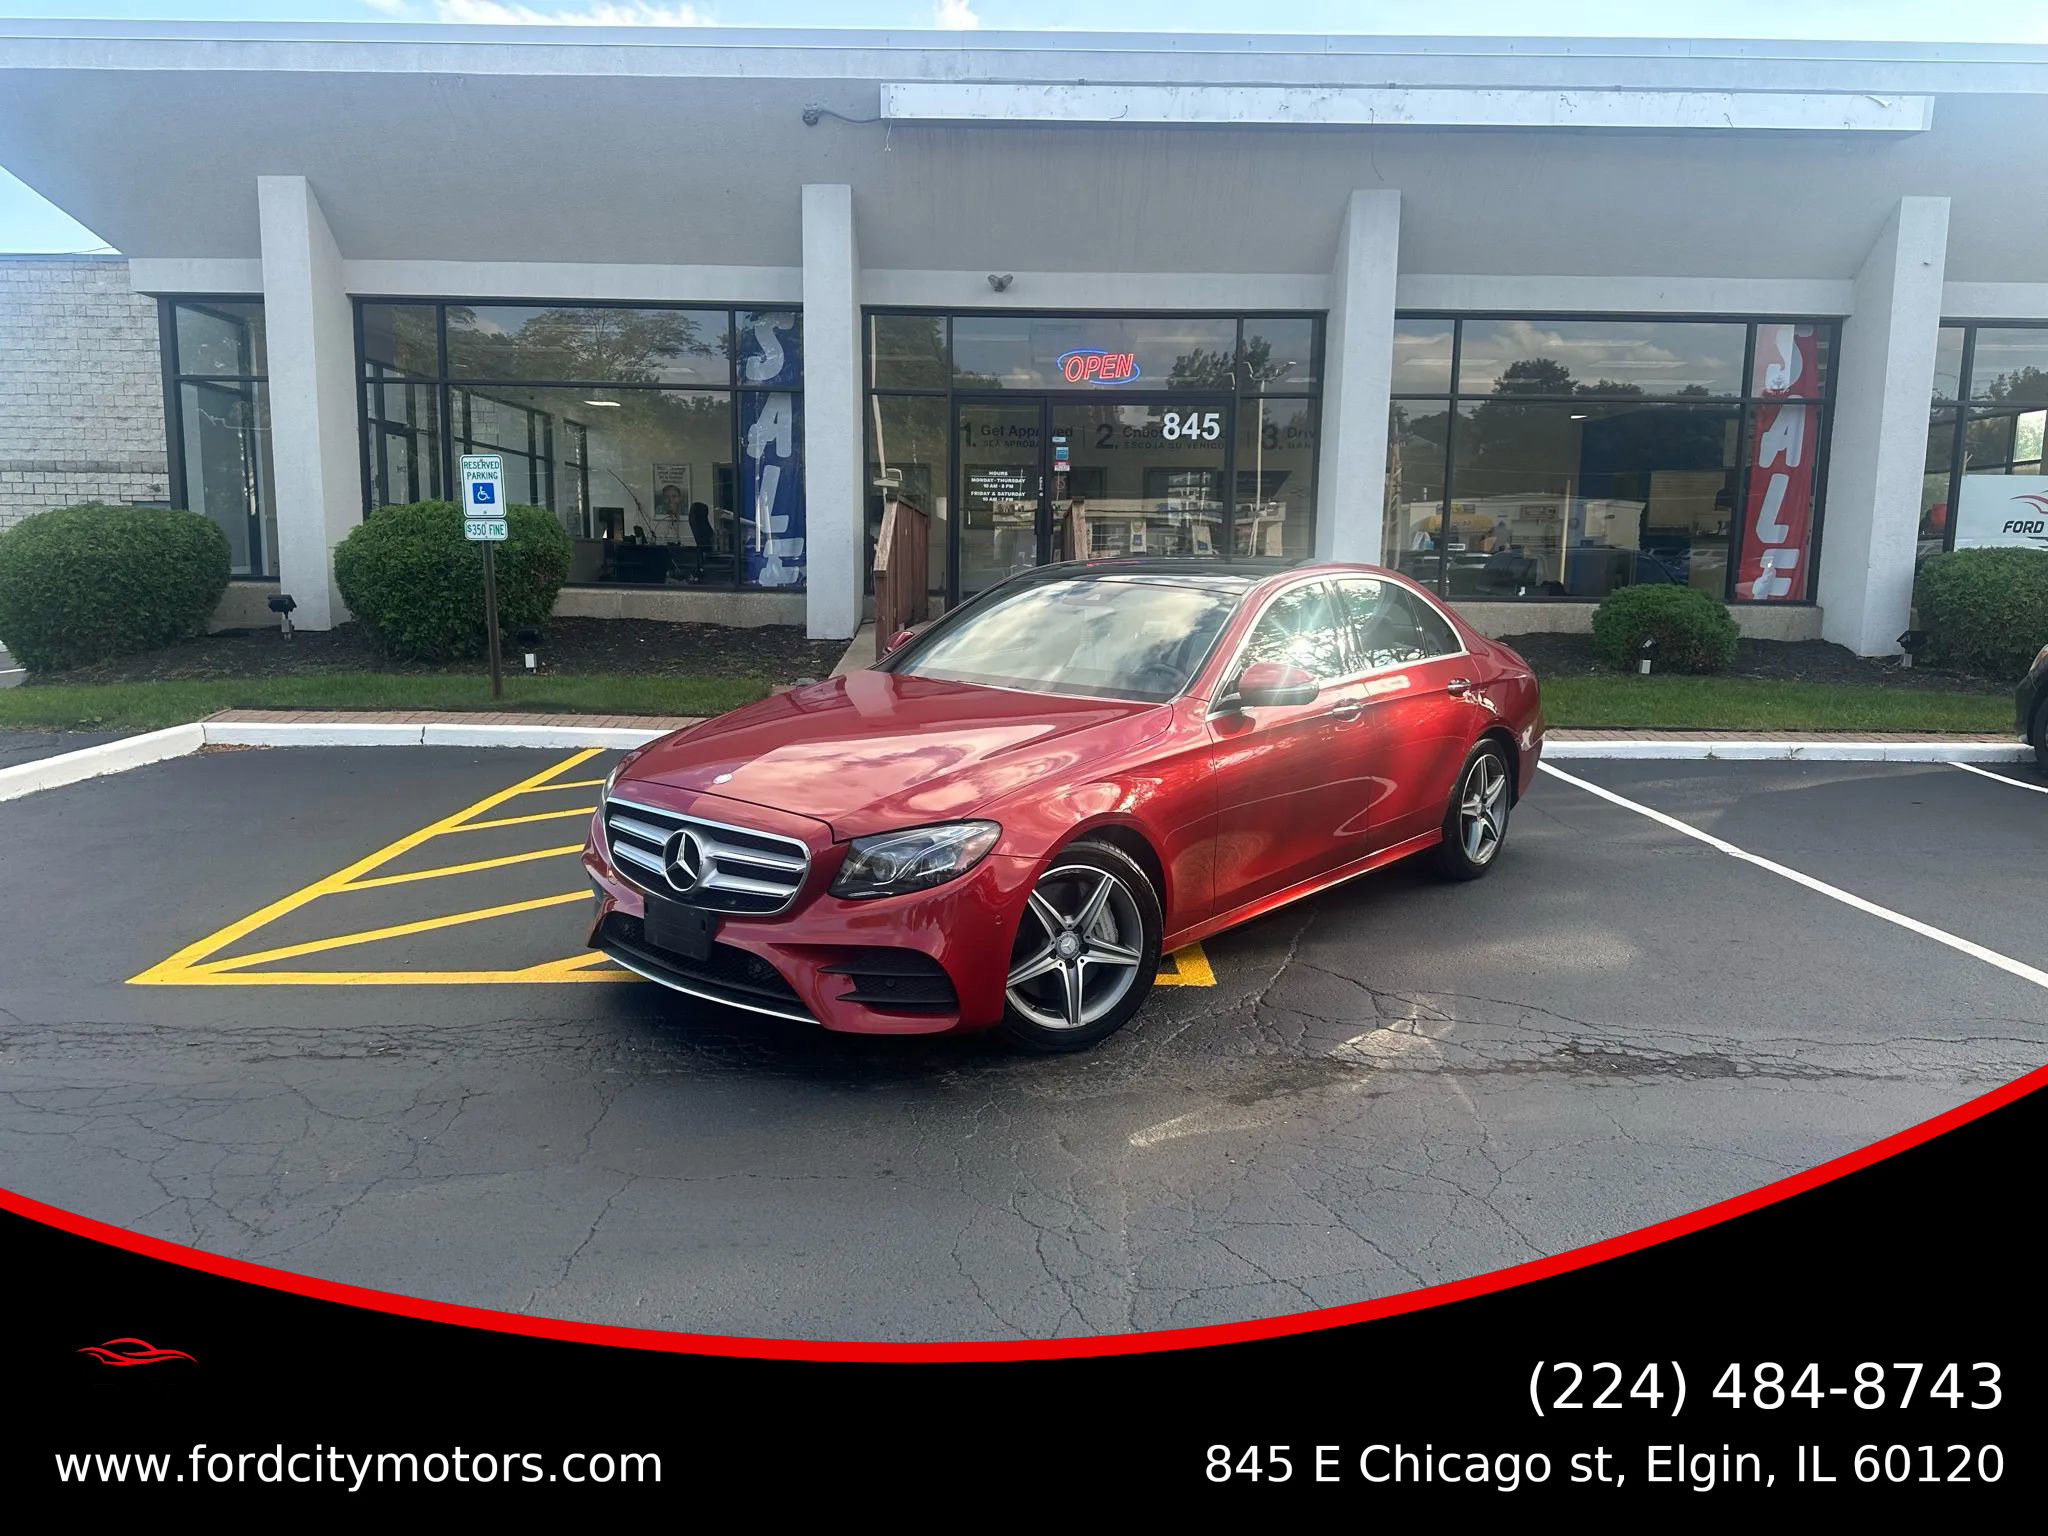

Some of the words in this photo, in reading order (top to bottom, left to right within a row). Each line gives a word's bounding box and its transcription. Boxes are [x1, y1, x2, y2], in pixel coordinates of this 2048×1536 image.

[1065, 354, 1134, 382] OPEN
[981, 425, 1004, 436] Get
[1163, 413, 1220, 440] 845
[1096, 424, 1119, 449] 2.
[746, 313, 804, 586] SALE
[464, 461, 499, 469] RESERVED
[1752, 325, 1813, 599] SALE
[467, 472, 498, 480] PARKING
[467, 524, 487, 535] $350
[489, 524, 505, 535] FINE
[2002, 520, 2045, 533] FORD
